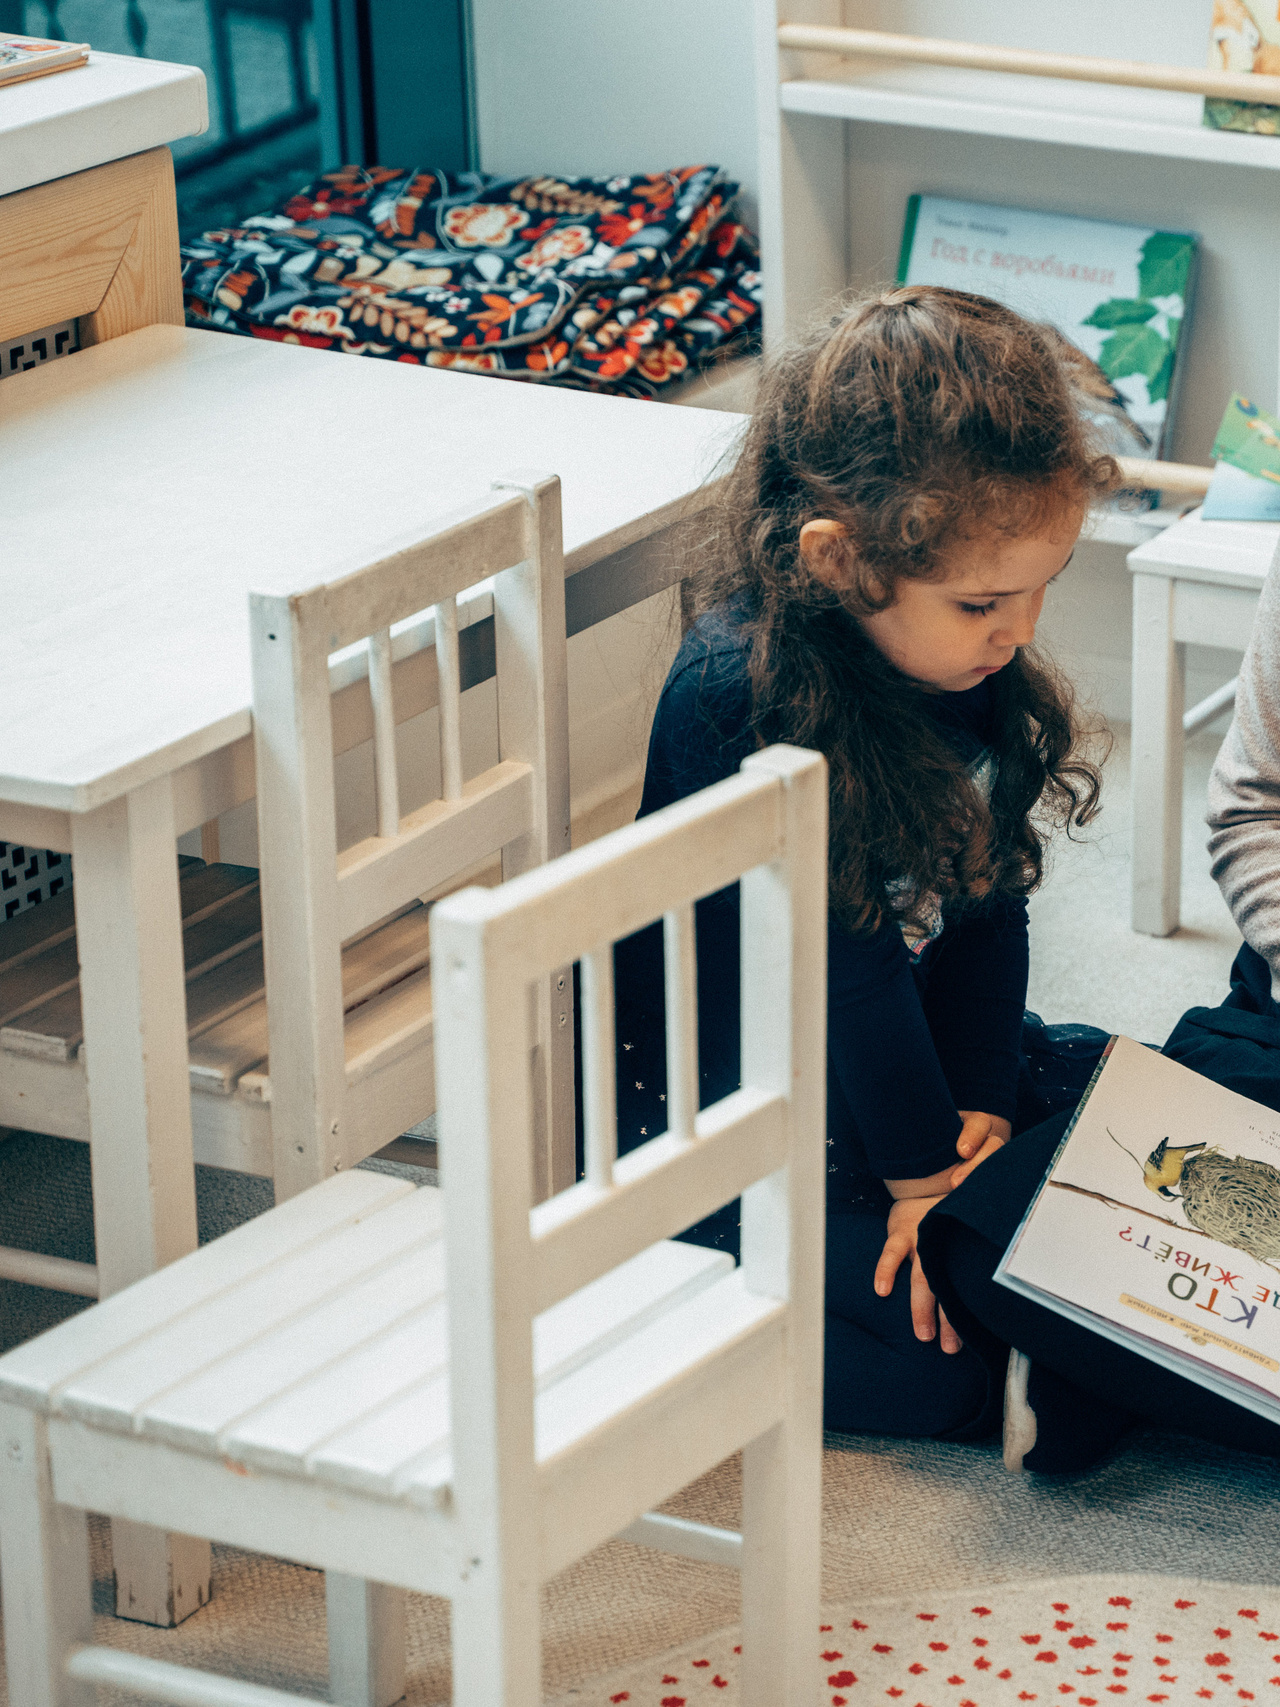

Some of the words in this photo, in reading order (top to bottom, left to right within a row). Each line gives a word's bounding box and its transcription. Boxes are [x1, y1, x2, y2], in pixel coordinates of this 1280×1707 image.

[930, 237, 968, 264] Год
[972, 248, 986, 265] с
[991, 252, 1116, 285] воробьями
[1119, 1226, 1244, 1291] ЖИВЁТ?
[1168, 1272, 1259, 1329] КТО
[1203, 1331, 1271, 1367] УДИВИТЕЛЬНЫЙ
